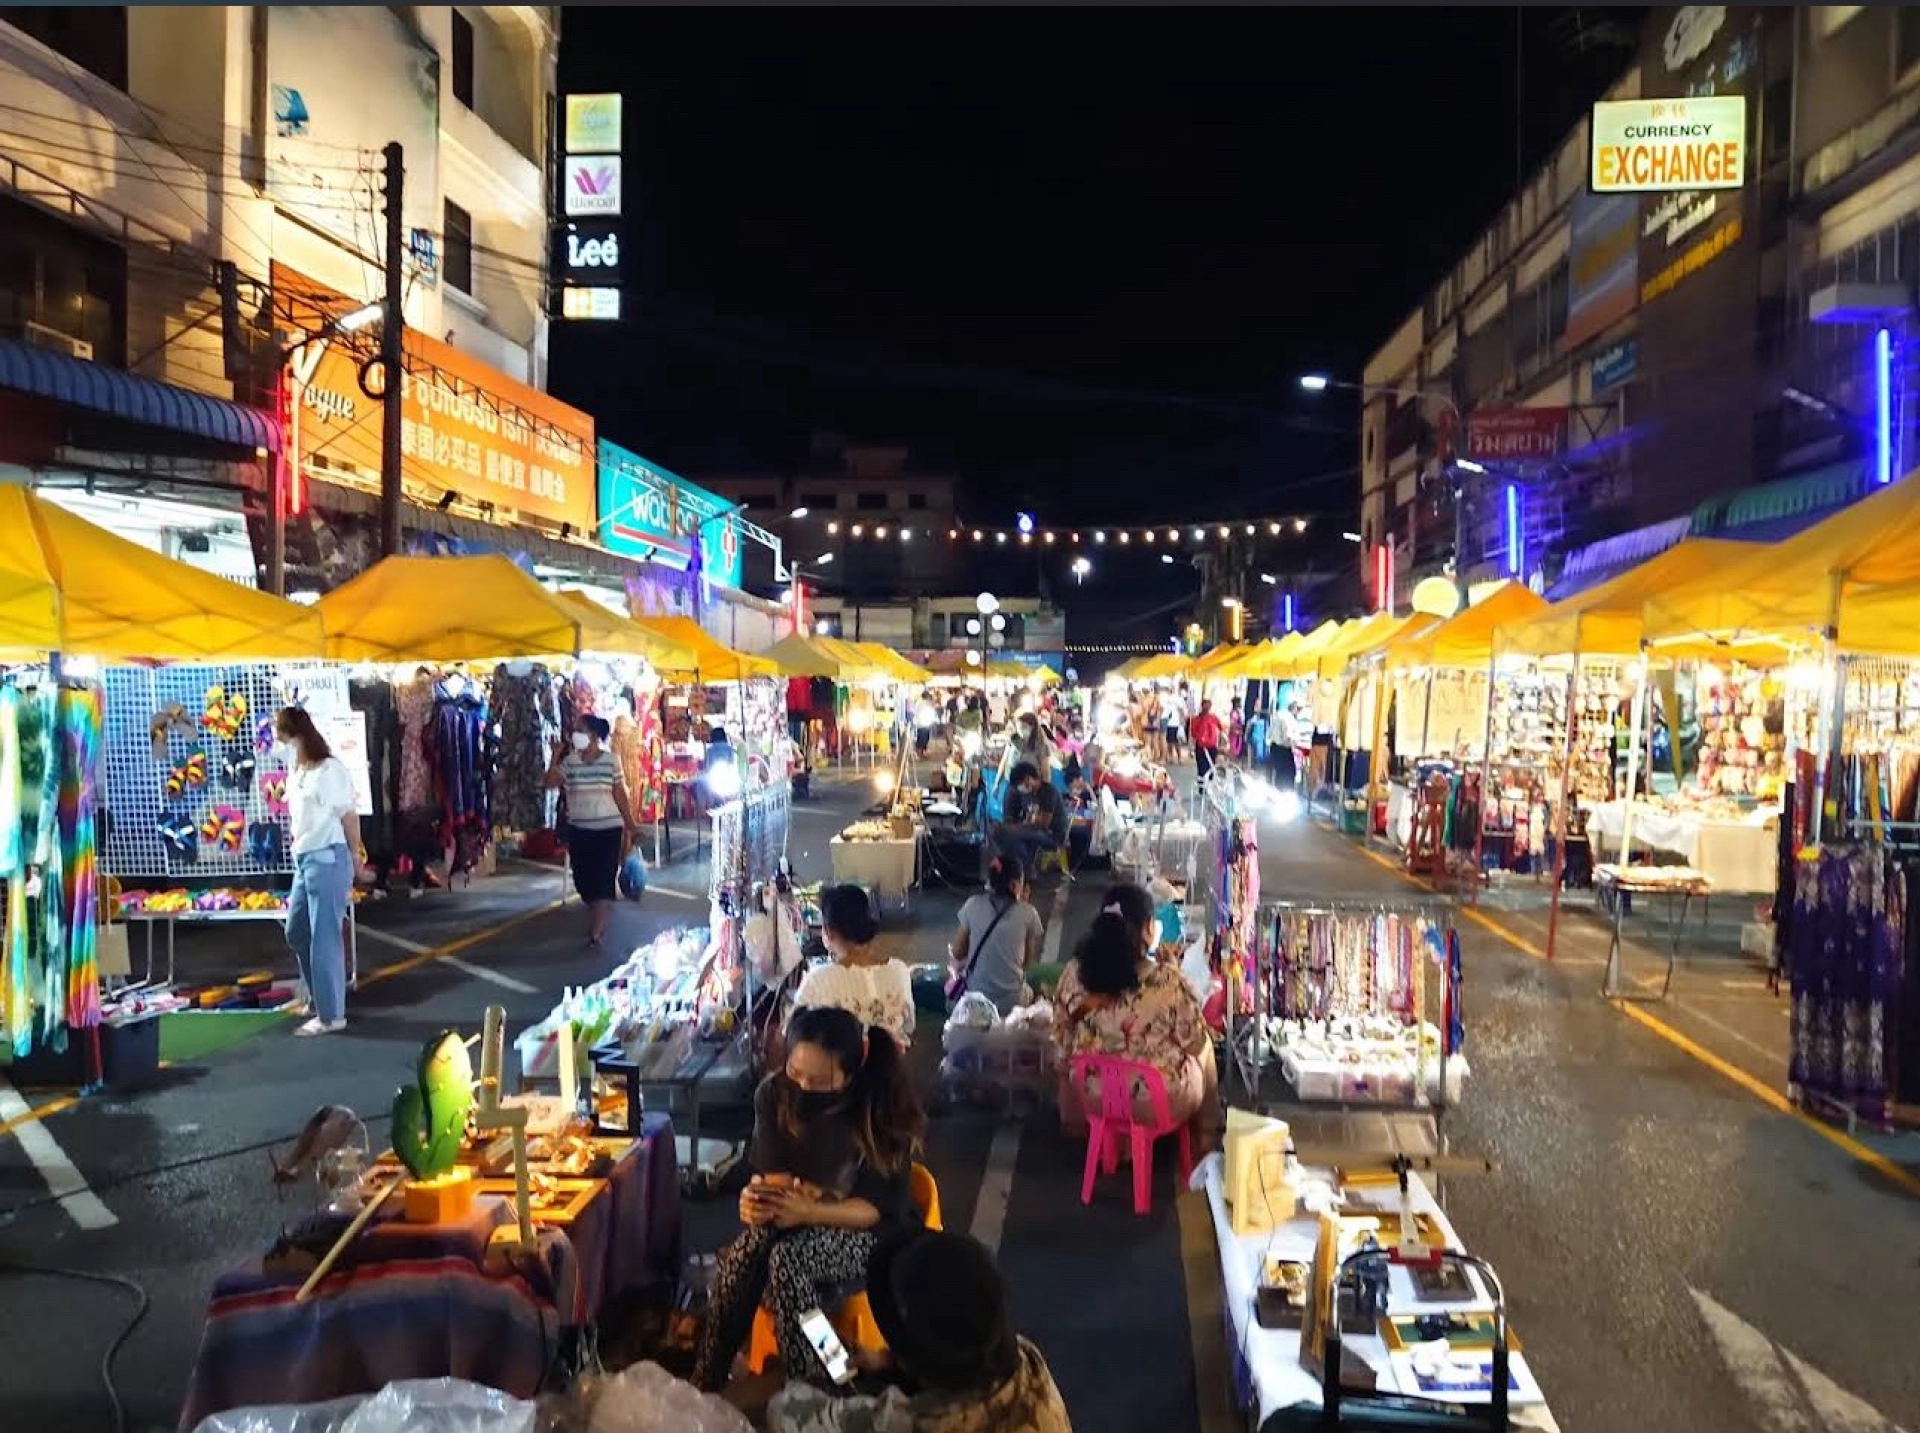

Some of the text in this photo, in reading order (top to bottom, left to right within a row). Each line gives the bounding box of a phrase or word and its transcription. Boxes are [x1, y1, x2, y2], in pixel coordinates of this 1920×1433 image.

[1624, 124, 1713, 138] CURRENCY
[1599, 142, 1738, 186] EXCHANGE
[567, 229, 619, 267] Lee
